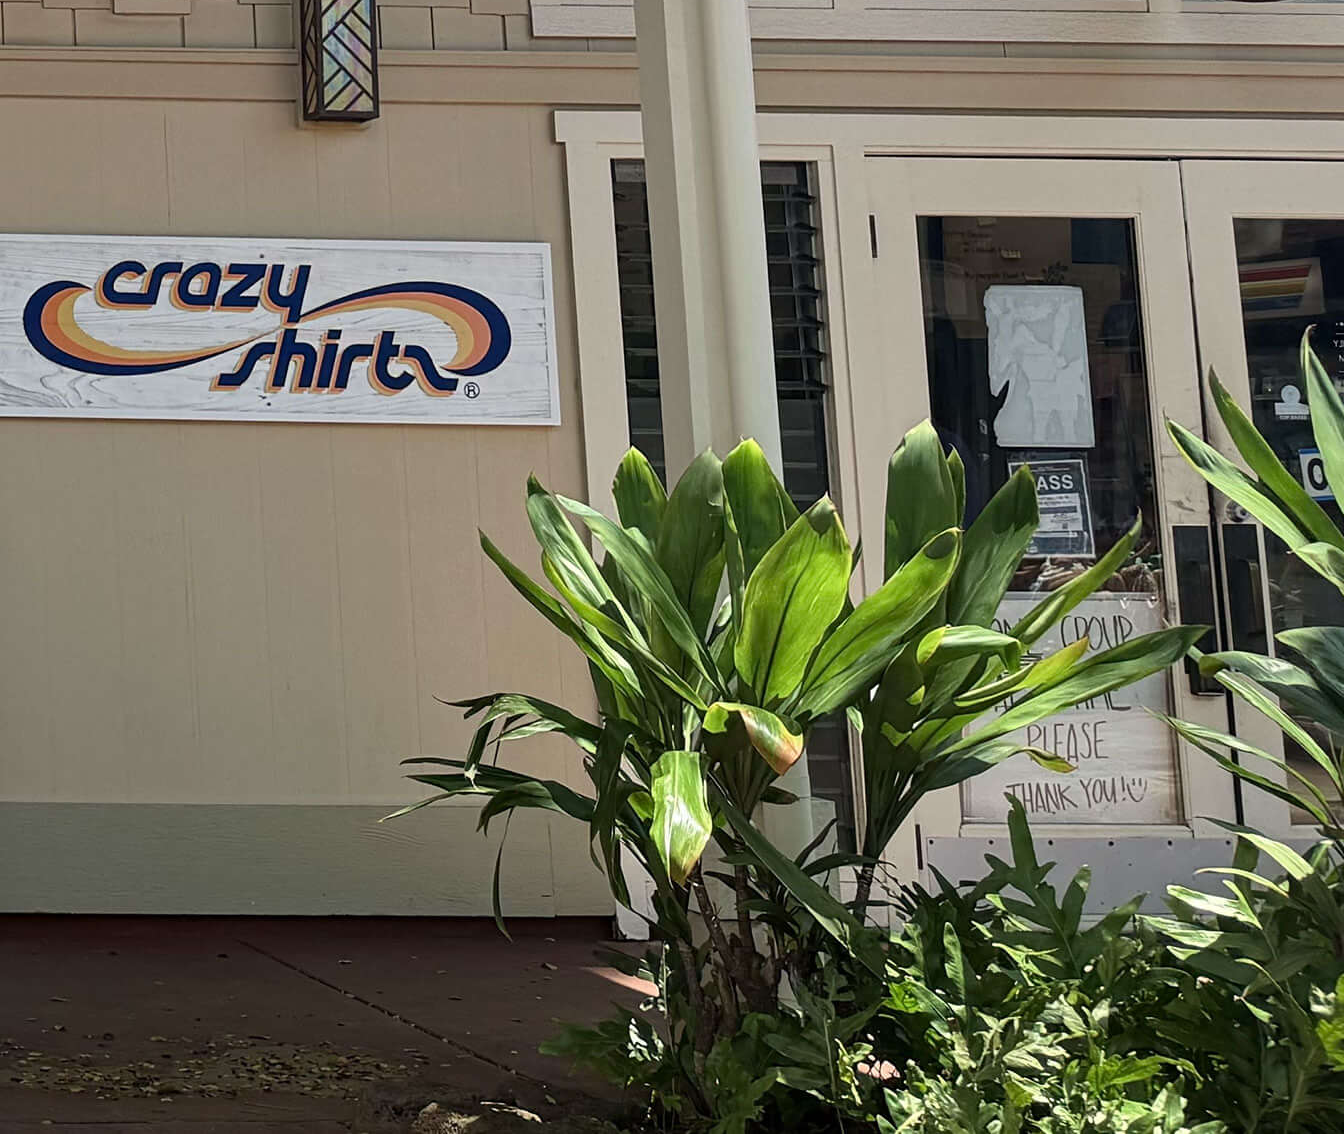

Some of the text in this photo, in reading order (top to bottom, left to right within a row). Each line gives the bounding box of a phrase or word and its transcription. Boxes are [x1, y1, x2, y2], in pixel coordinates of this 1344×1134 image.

[94, 260, 311, 326] crazy
[209, 330, 459, 396] shirts
[1037, 474, 1074, 491] ASS
[1027, 721, 1109, 762] PLEASE
[1006, 782, 1078, 815] THANK
